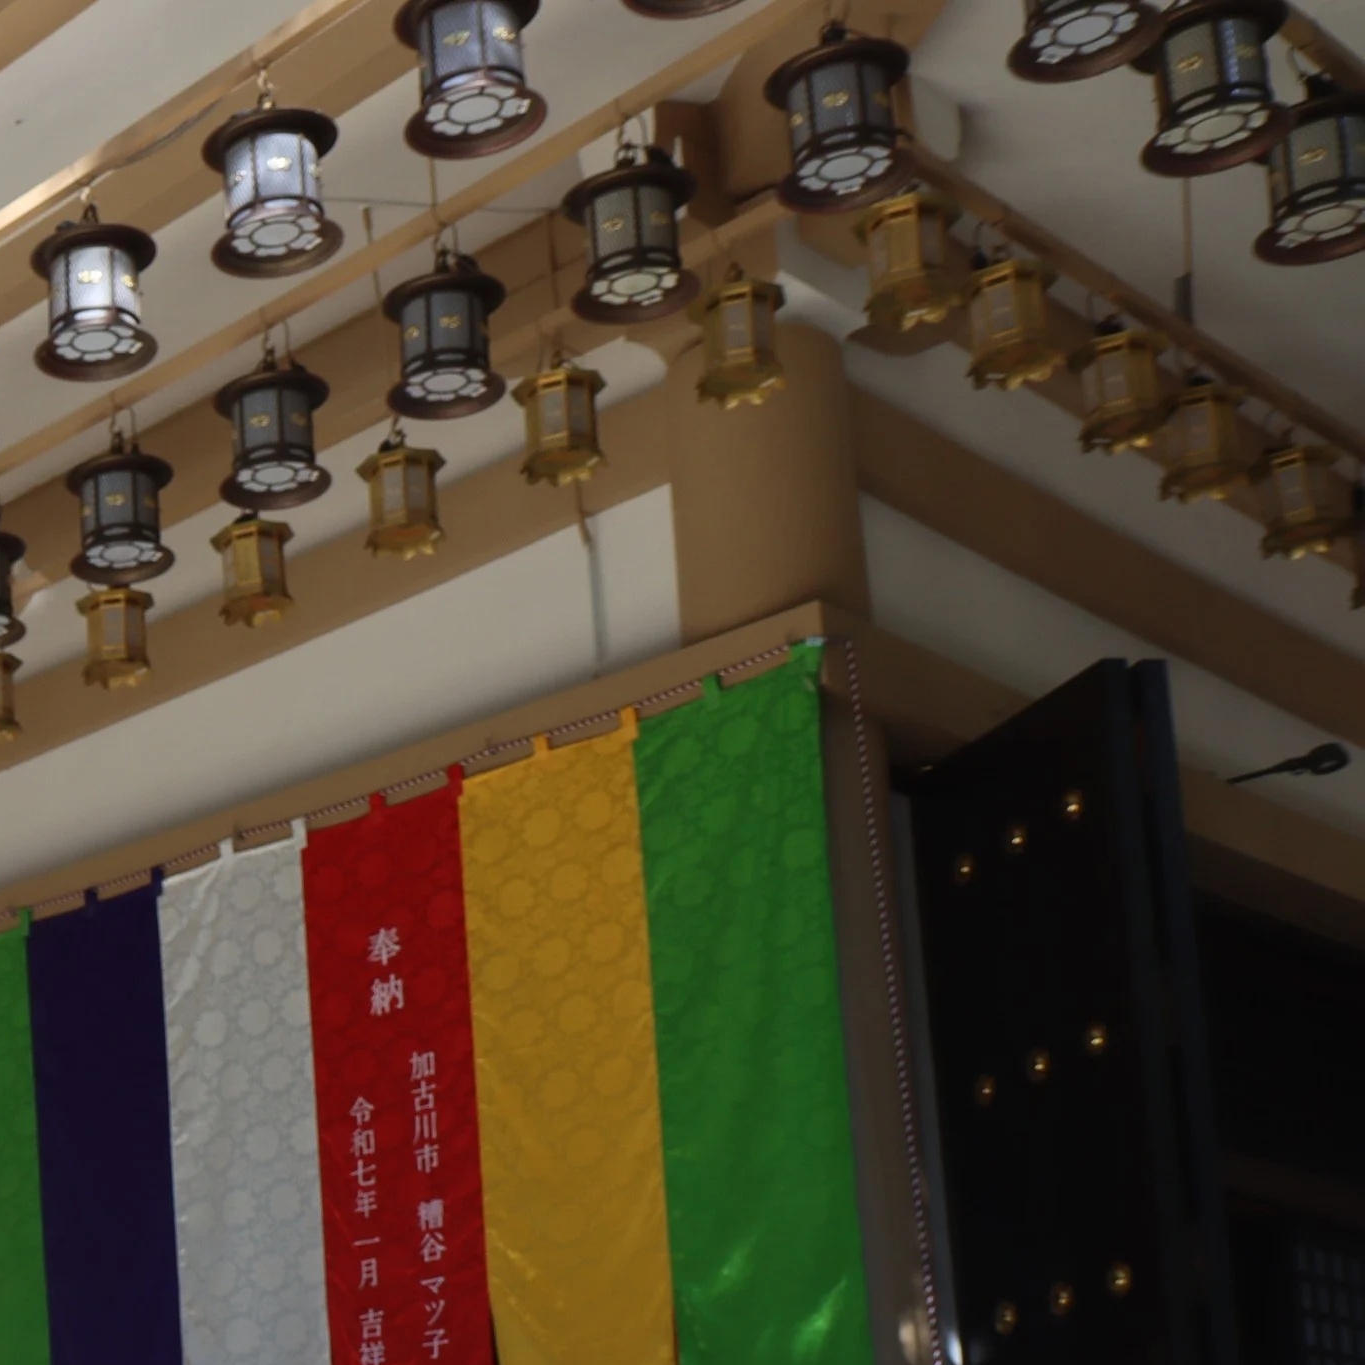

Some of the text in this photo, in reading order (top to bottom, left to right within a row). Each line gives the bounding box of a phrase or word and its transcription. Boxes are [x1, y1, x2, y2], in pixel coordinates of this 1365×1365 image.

[367, 926, 404, 1016] 奉納
[408, 1051, 440, 1174] 加古川市
